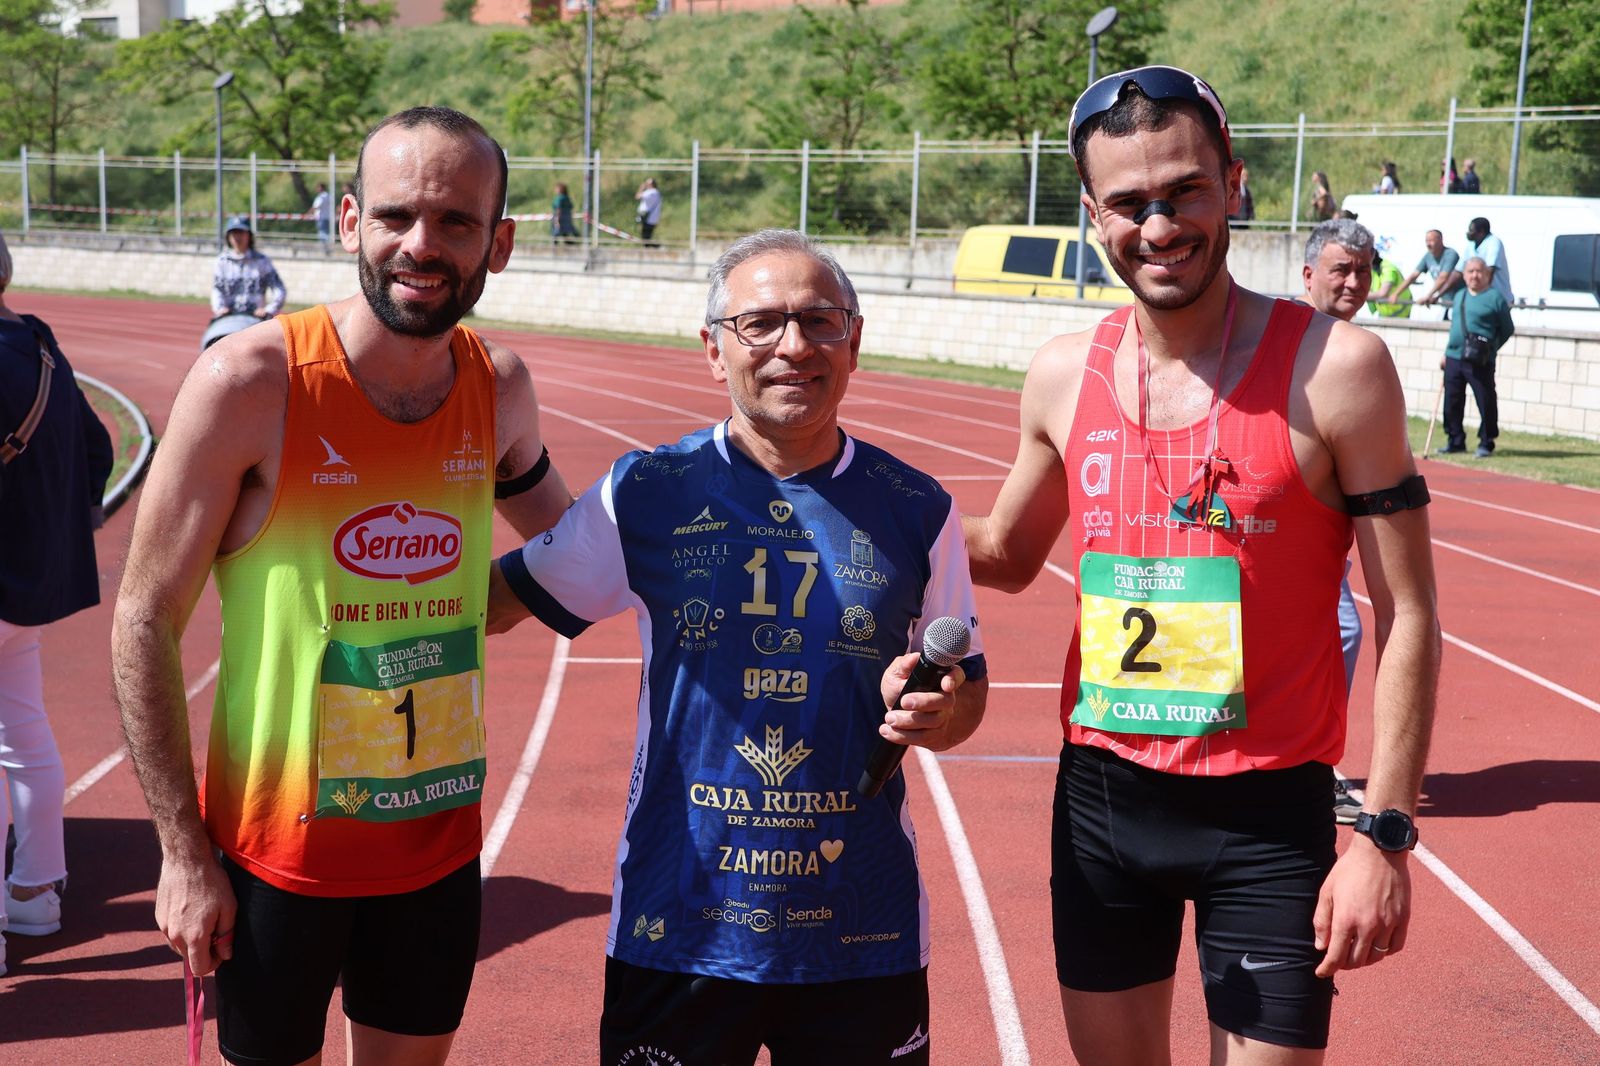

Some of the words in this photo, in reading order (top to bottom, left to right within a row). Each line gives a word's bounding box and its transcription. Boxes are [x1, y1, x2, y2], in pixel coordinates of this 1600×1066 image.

[1086, 428, 1120, 443] 42K
[672, 521, 729, 536] MERCURY
[747, 525, 815, 540] MORALEJO
[347, 525, 459, 561] Serrano
[671, 544, 732, 560] ANGEL
[741, 547, 818, 618] 17
[833, 563, 889, 586] ZAMORA
[1138, 578, 1185, 590] RURAL
[376, 602, 409, 622] BIEN
[414, 600, 423, 619] Y
[1121, 606, 1162, 673] 2
[378, 661, 407, 678] CAJA
[408, 654, 443, 672] RURAL
[378, 678, 390, 688] DE
[743, 667, 809, 700] gaza
[1112, 702, 1161, 721] CAJA
[1166, 703, 1237, 724] RURAL
[394, 688, 416, 761] 1
[374, 790, 422, 810] CAJA
[425, 774, 480, 803] RURAL
[690, 783, 754, 811] CAJA
[762, 790, 857, 813] RURAL
[727, 814, 747, 826] DE
[752, 816, 816, 829] ZAMORA
[718, 845, 821, 876] ZAMORA
[748, 882, 788, 893] ENAMORA
[786, 905, 833, 921] Senda
[618, 1048, 636, 1066] LUB
